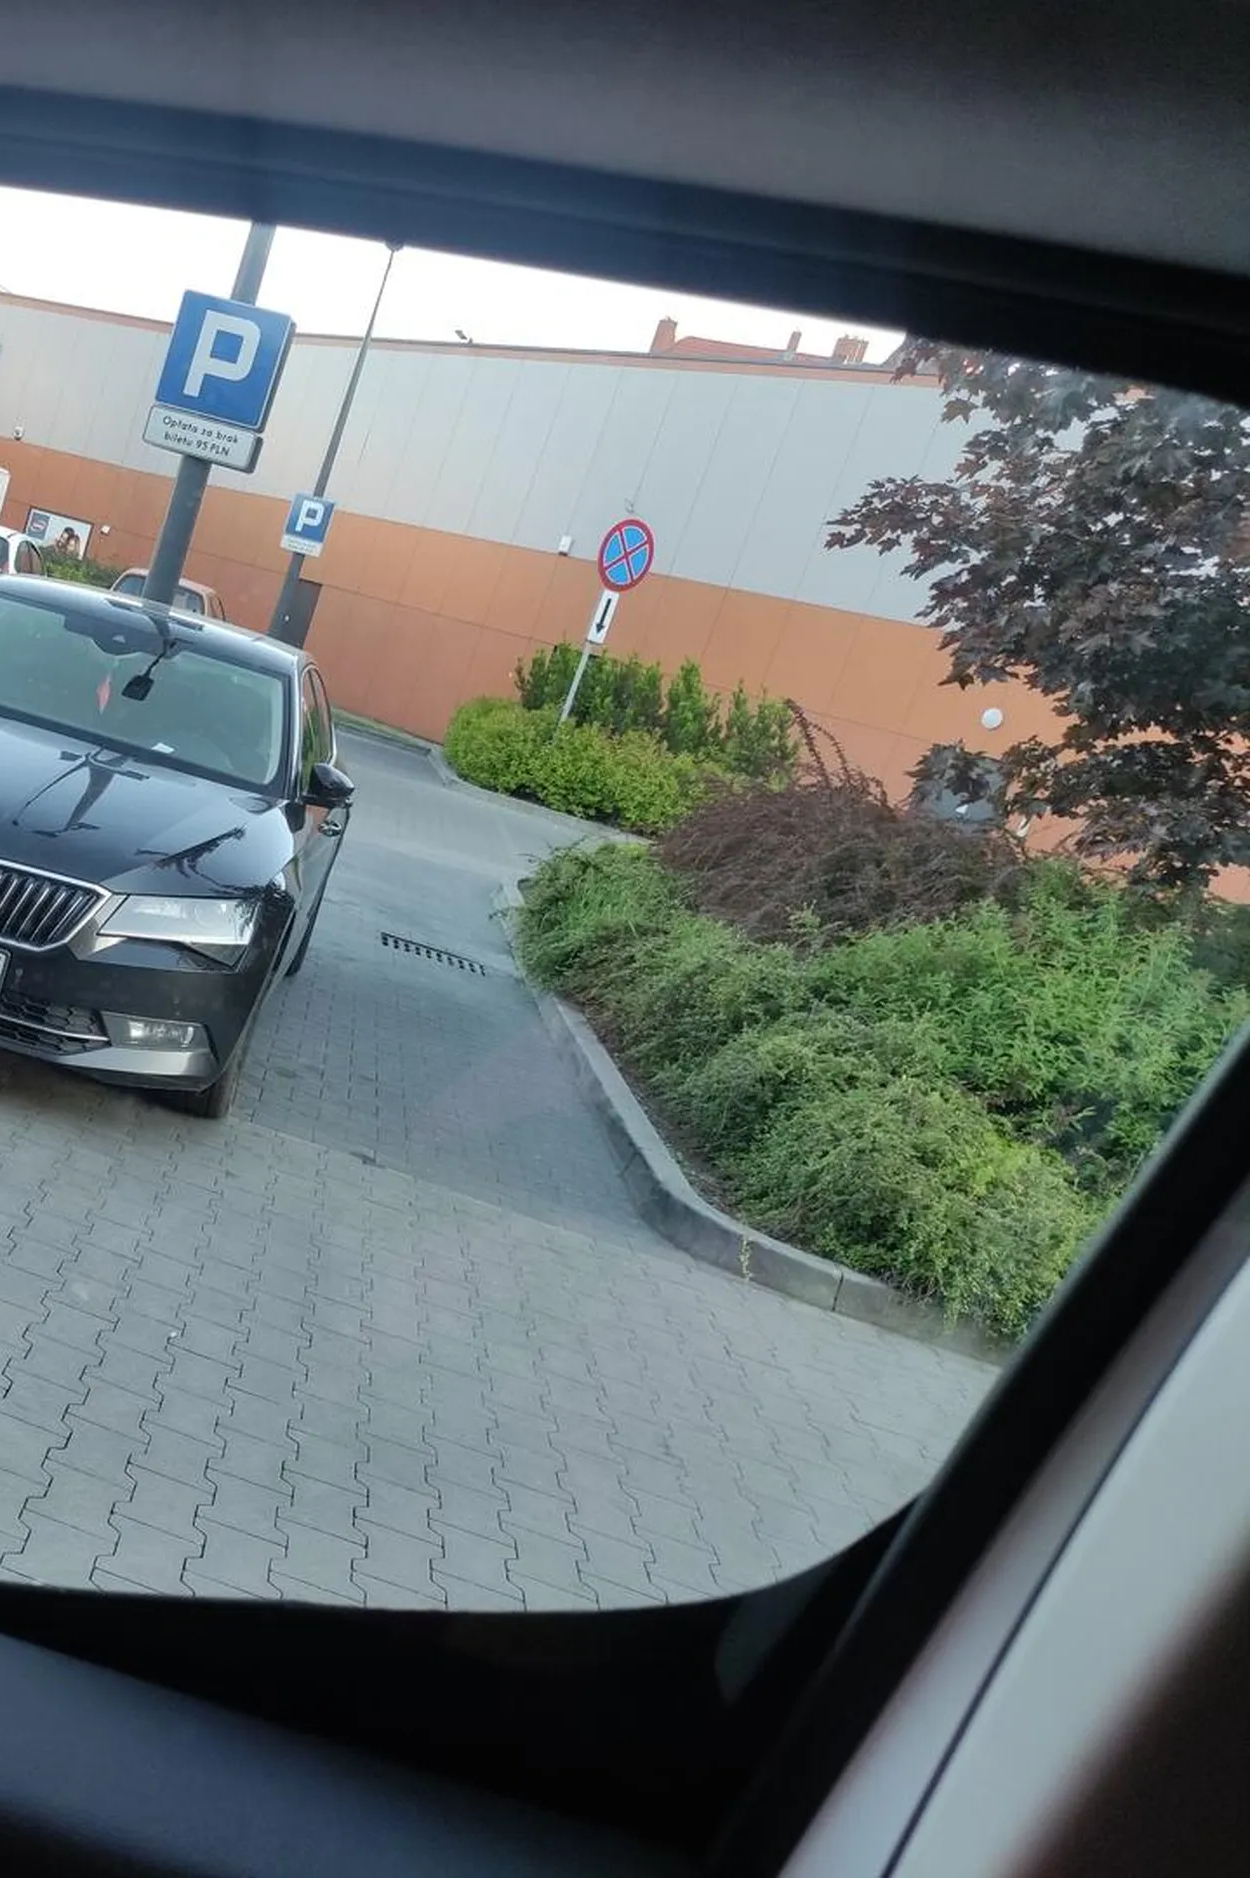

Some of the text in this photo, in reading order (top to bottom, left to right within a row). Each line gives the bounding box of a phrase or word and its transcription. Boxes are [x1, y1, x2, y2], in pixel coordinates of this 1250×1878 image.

[183, 308, 261, 397] P
[216, 430, 238, 443] brak
[295, 499, 324, 532] P
